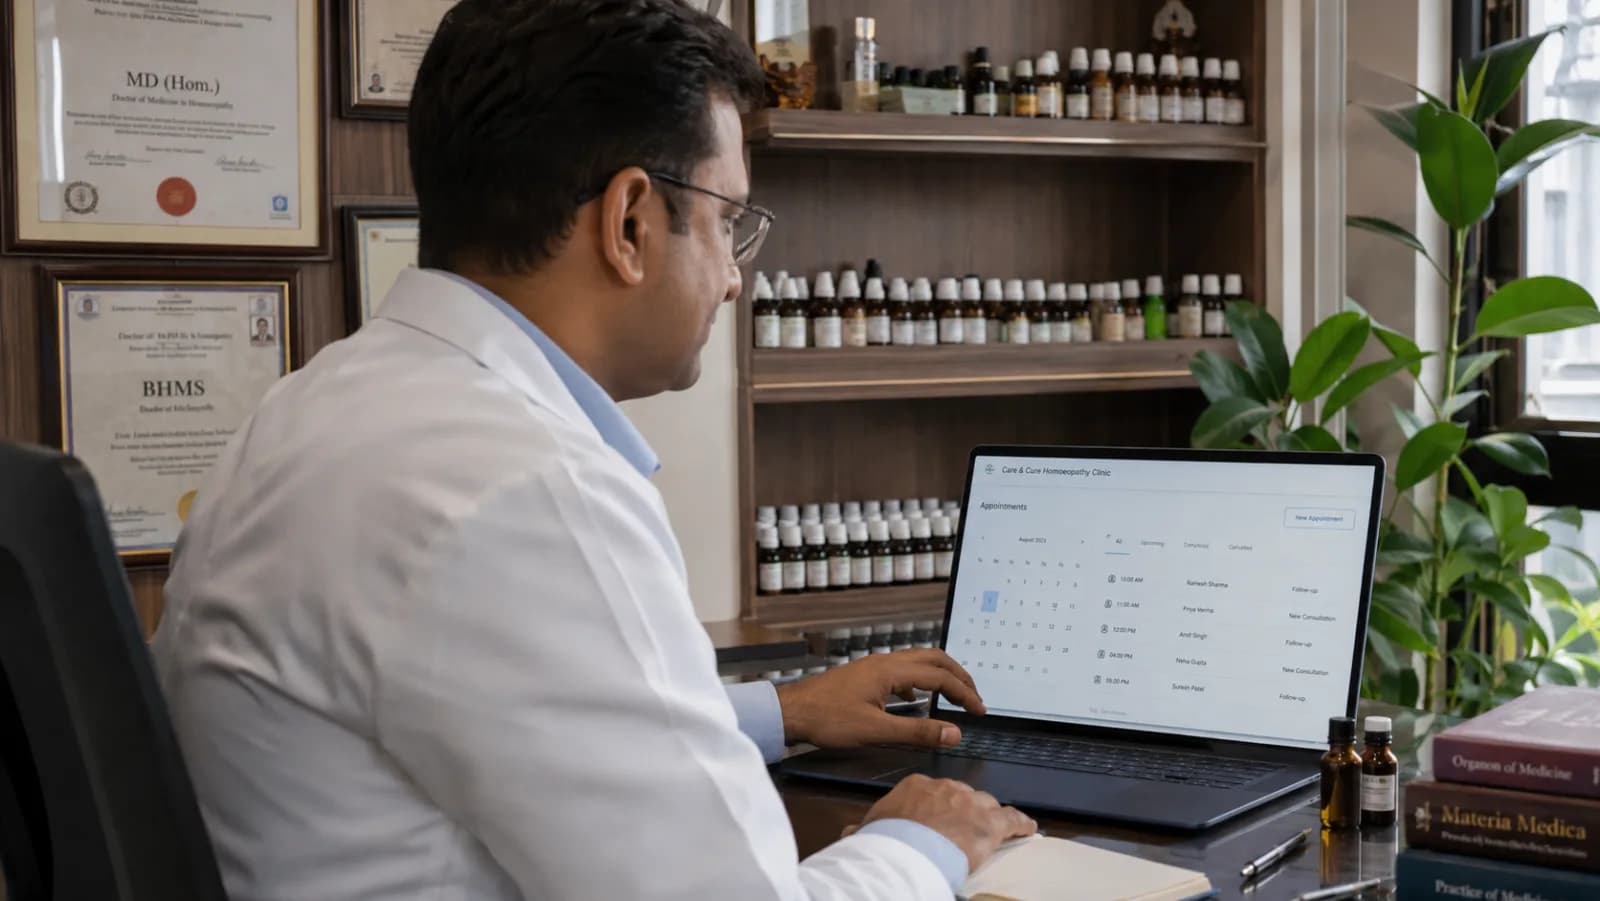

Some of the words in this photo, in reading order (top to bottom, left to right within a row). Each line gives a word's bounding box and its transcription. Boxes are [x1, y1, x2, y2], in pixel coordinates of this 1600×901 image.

[126, 71, 159, 88] MD
[163, 74, 221, 96] (Hom.)
[143, 380, 205, 397] BHMS
[1002, 466, 1019, 474] Care
[1019, 465, 1024, 474] &
[1025, 466, 1041, 474] Cure
[1092, 468, 1111, 477] Clinic
[980, 502, 1028, 511] Appointments
[1452, 754, 1501, 772] Organon
[1503, 761, 1518, 774] of
[1518, 763, 1573, 781] Medicine
[1441, 804, 1512, 831] Materia
[1516, 814, 1587, 841] Medica
[1434, 879, 1483, 899] Practice
[1484, 888, 1498, 900] of
